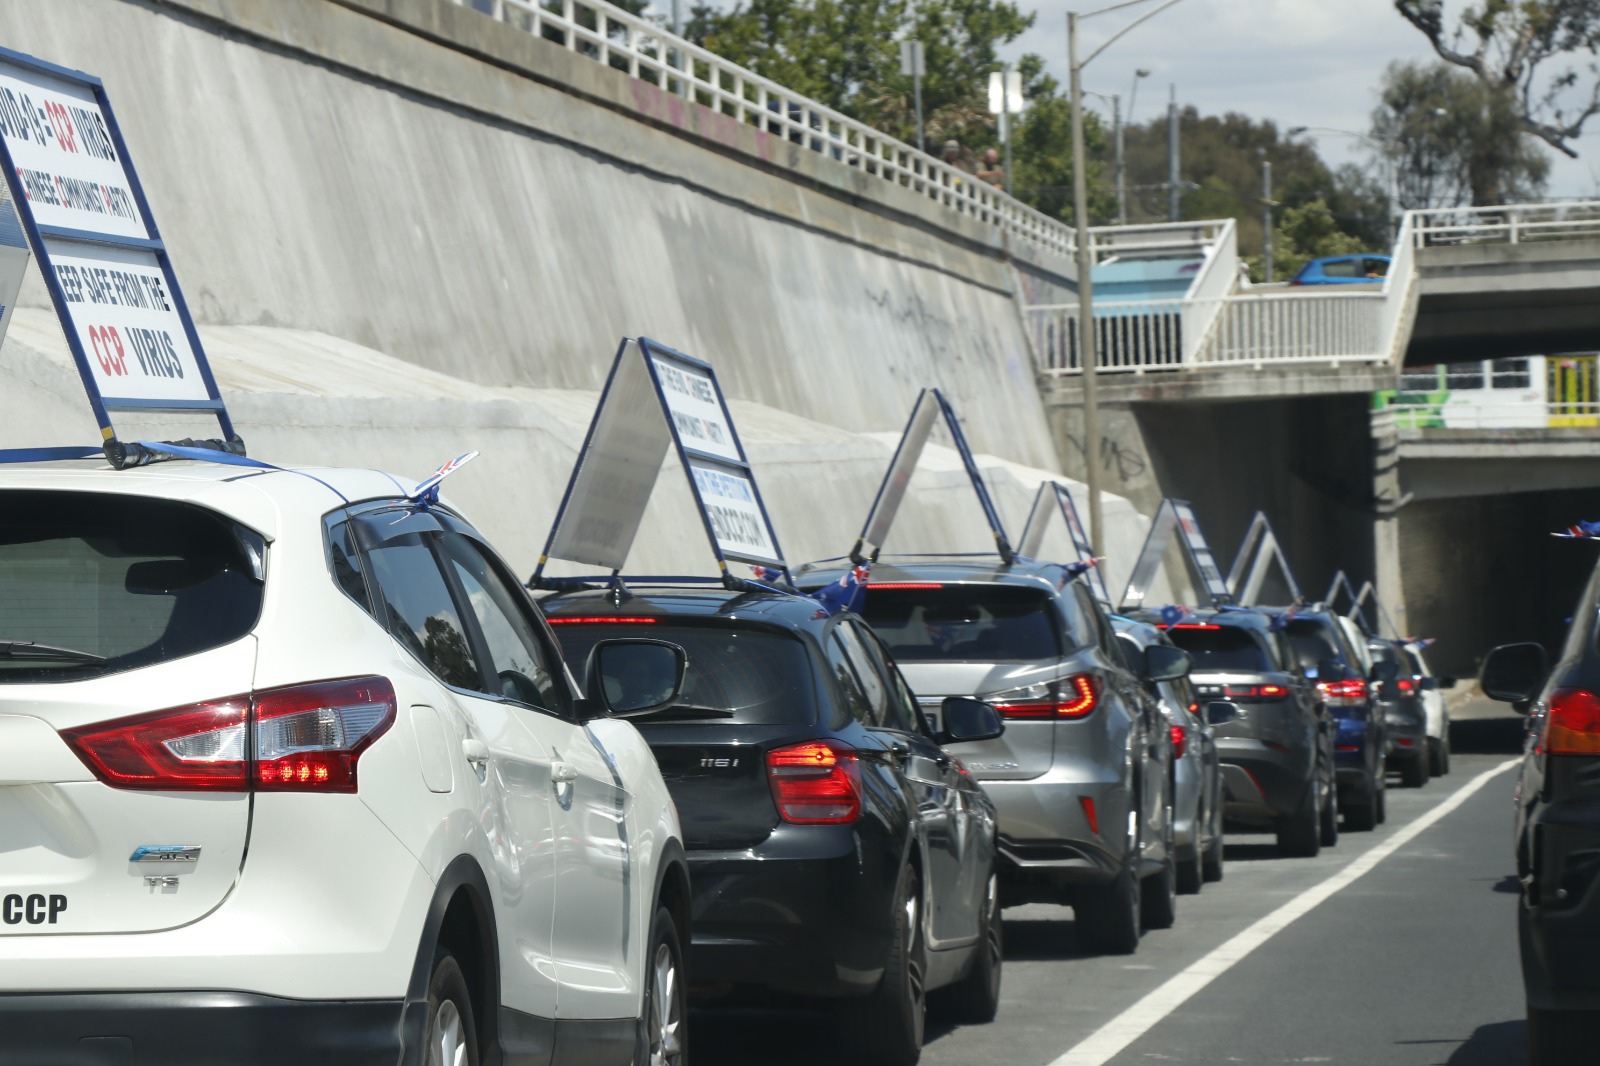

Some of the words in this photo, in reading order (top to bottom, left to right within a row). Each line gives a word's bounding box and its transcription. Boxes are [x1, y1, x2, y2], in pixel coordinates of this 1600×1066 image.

[44, 99, 79, 154] CCP
[68, 105, 116, 162] VIRUS
[54, 175, 107, 215] COMMUNIST
[80, 266, 118, 305] SAFE
[110, 269, 148, 309] FROM
[142, 275, 171, 312] THE
[88, 324, 129, 377] CCP
[124, 326, 184, 380] VIRUS
[3, 893, 68, 925] CCP
